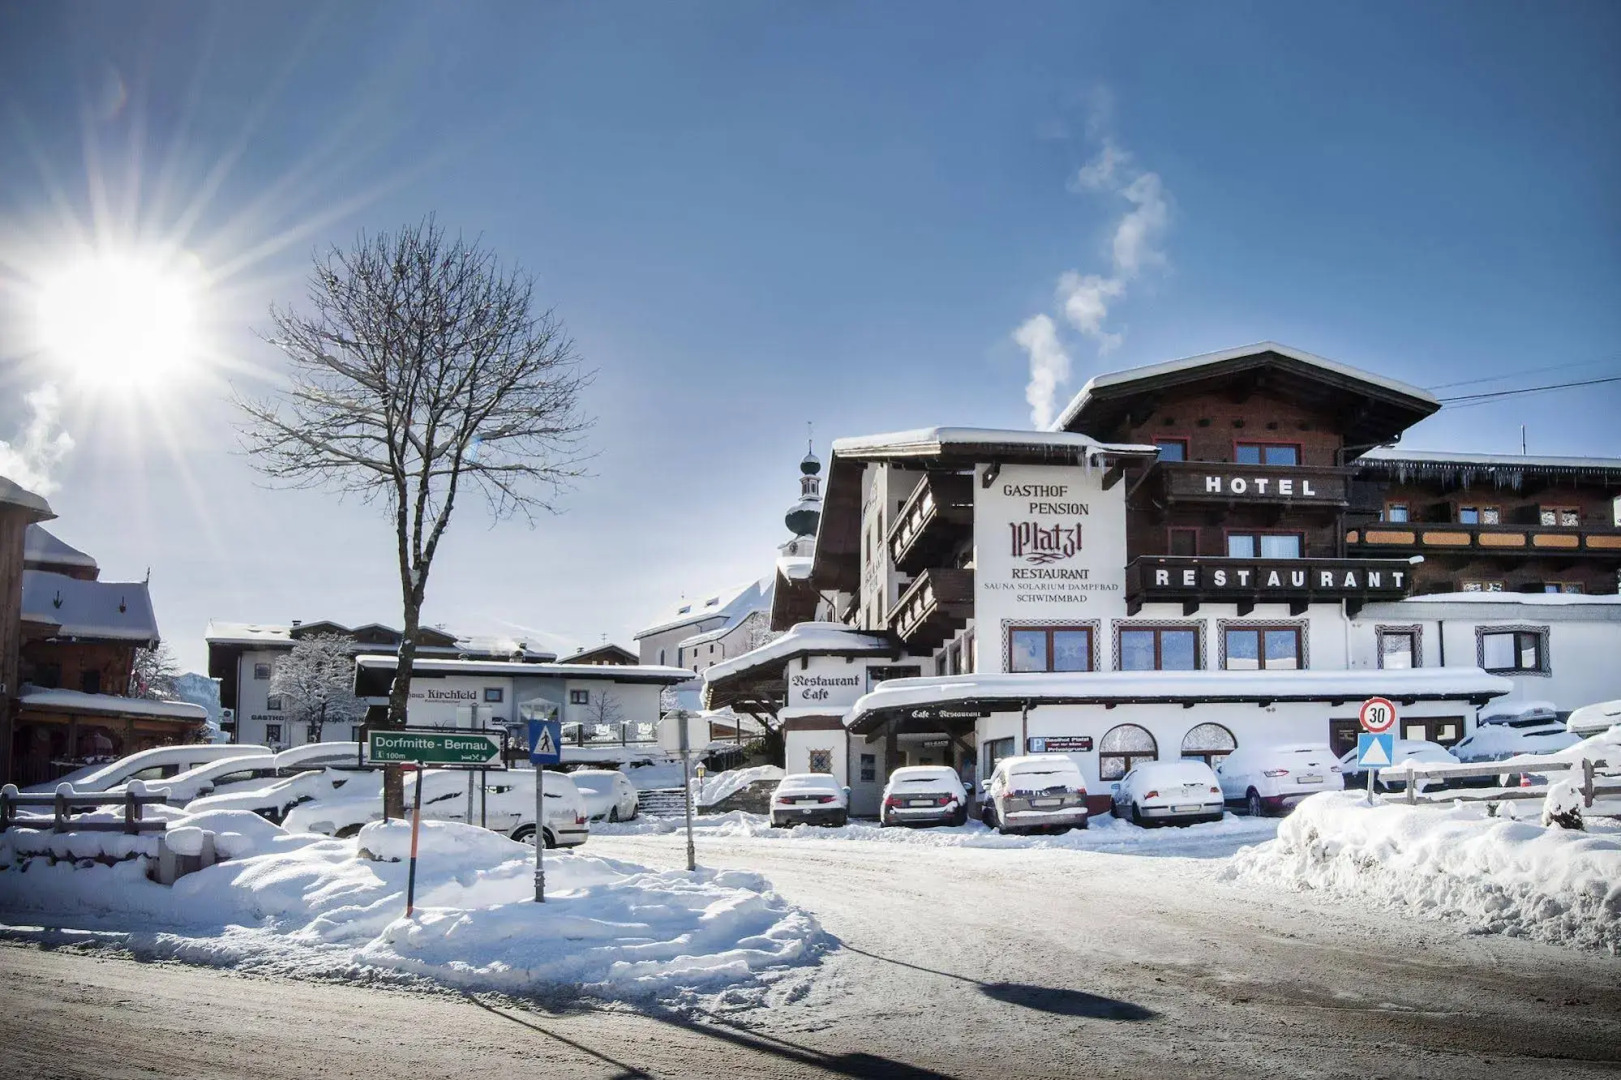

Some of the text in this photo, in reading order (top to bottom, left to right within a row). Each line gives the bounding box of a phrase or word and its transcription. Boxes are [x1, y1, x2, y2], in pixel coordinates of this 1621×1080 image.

[1003, 485, 1068, 497] GASTHOF
[1206, 476, 1316, 496] HOTEL
[1029, 503, 1089, 515] PENSION
[1009, 520, 1083, 559] Platzl
[1011, 569, 1090, 579] RESTAURANT
[1155, 569, 1404, 588] RESTAURANT
[984, 583, 1119, 592] SAUNA SOLARIUM DAMPFBAD
[1016, 595, 1088, 603] SCHWIMMBAD
[792, 675, 860, 687] Restaurant
[427, 689, 477, 700] Kirchfeld
[938, 710, 981, 718] Restaurant
[1369, 707, 1386, 724] 30
[375, 736, 435, 749] Dorfmitte
[444, 739, 488, 751] Bernau
[1033, 738, 1042, 751] P
[386, 752, 406, 760] 100m
